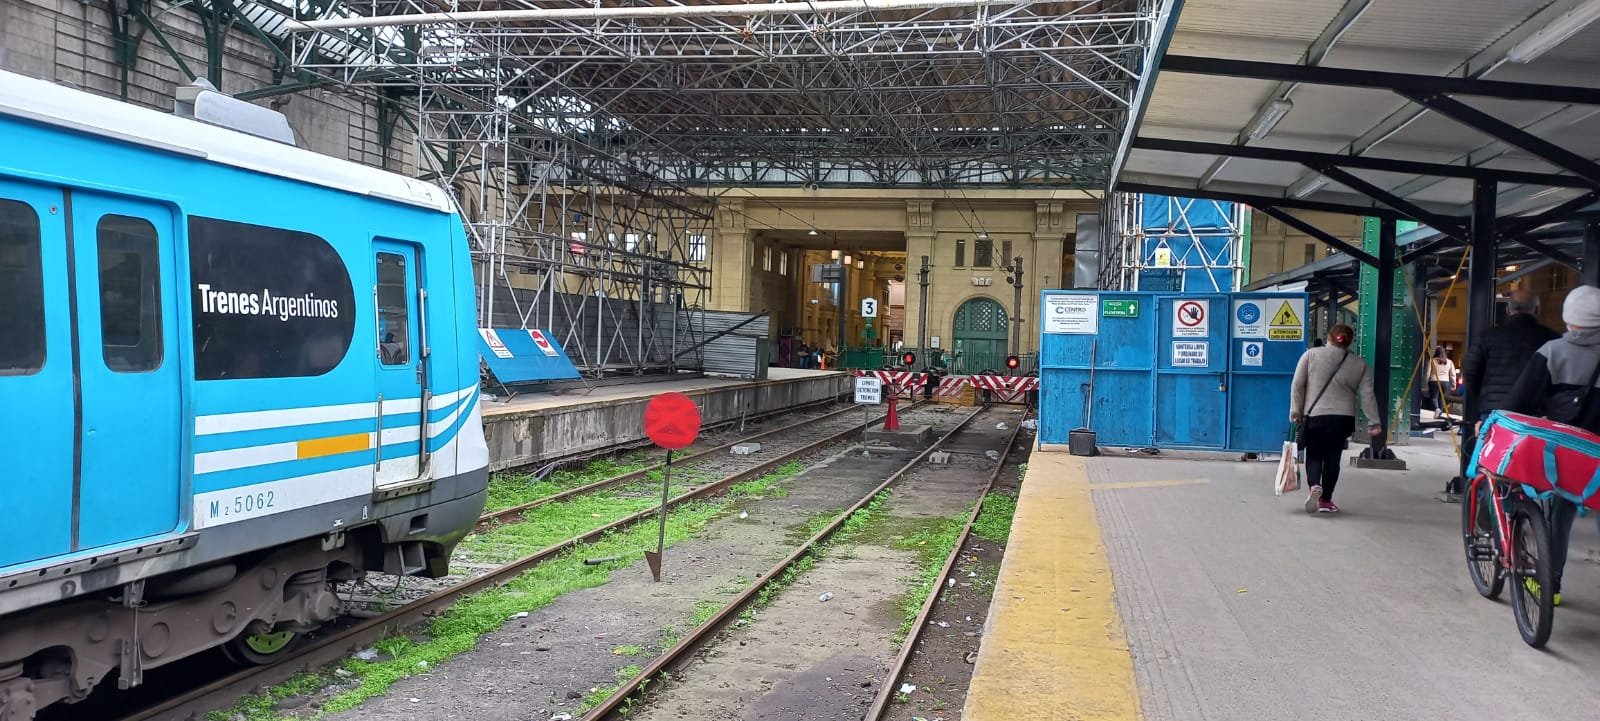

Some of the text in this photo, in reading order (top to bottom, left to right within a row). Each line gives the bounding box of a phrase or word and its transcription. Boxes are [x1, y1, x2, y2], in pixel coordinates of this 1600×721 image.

[198, 283, 339, 321] Trenes Argentinos
[865, 302, 874, 314] 3
[210, 500, 219, 518] M
[234, 490, 274, 513] 5062
